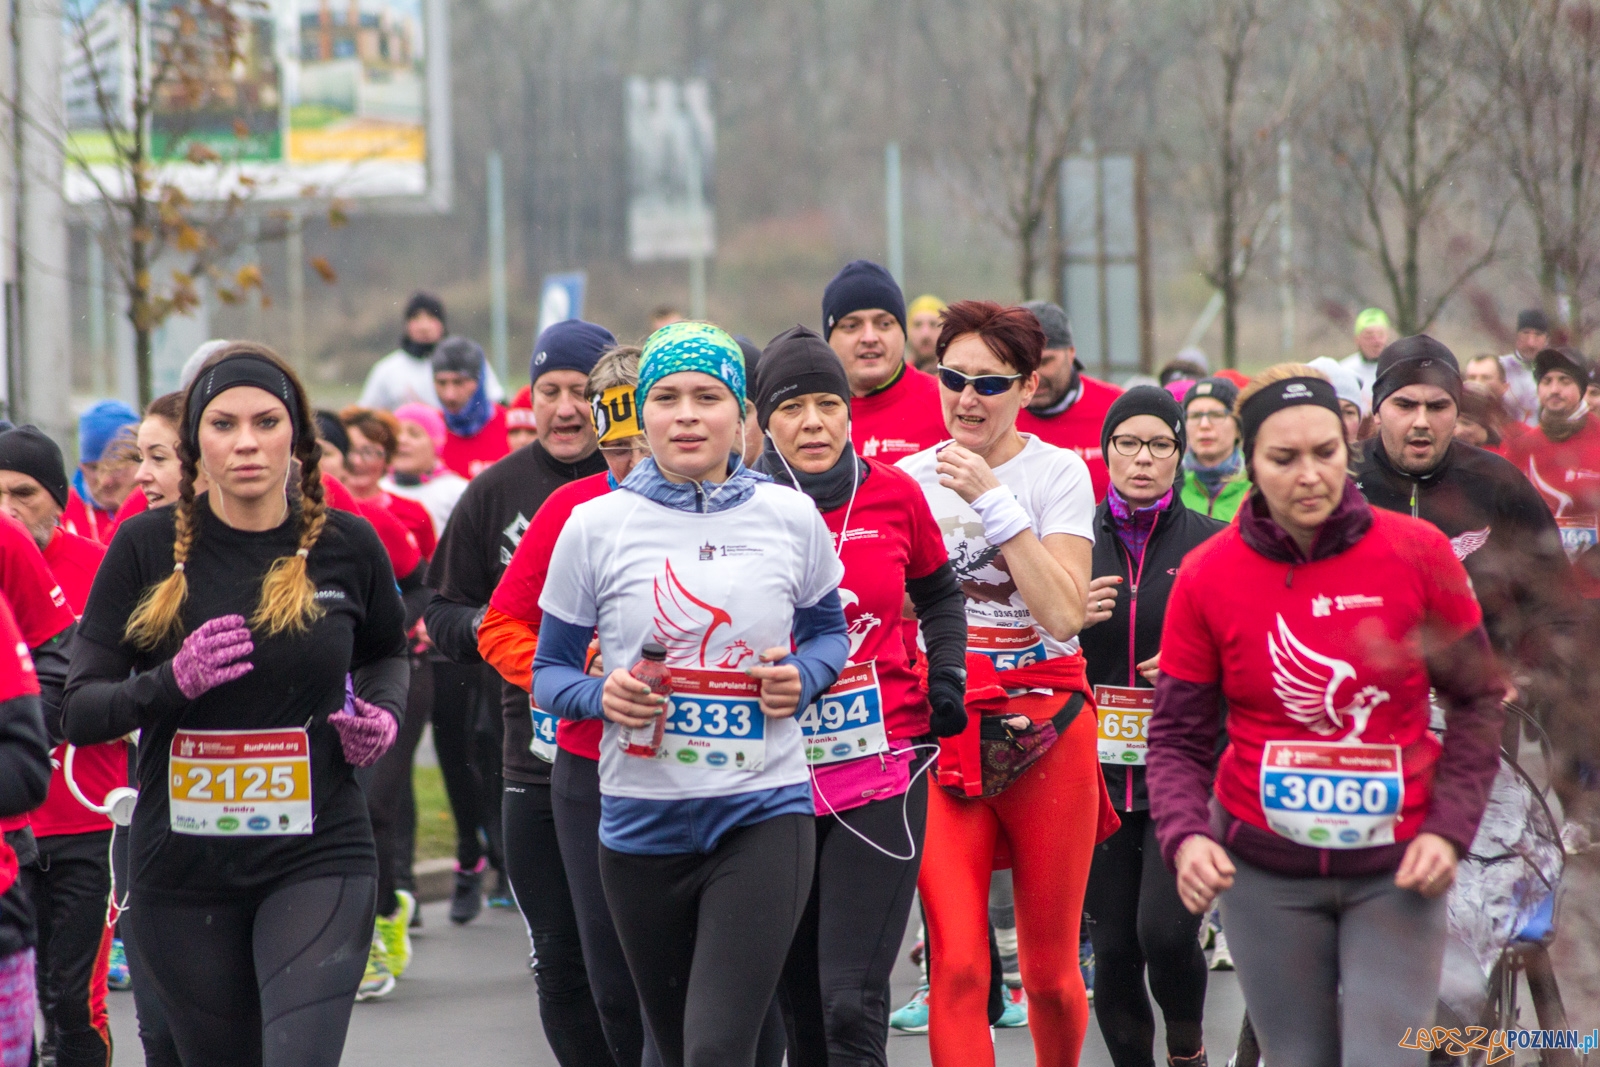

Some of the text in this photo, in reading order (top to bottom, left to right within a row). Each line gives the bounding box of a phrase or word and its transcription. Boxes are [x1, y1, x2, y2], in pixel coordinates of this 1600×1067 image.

[720, 545, 727, 557] 1
[708, 681, 758, 691] RunPoland.org
[798, 695, 869, 731] 494
[243, 742, 299, 752] RunPoland.org
[687, 739, 711, 747] Anita
[187, 766, 295, 799] 2125
[1280, 775, 1388, 813] 3060
